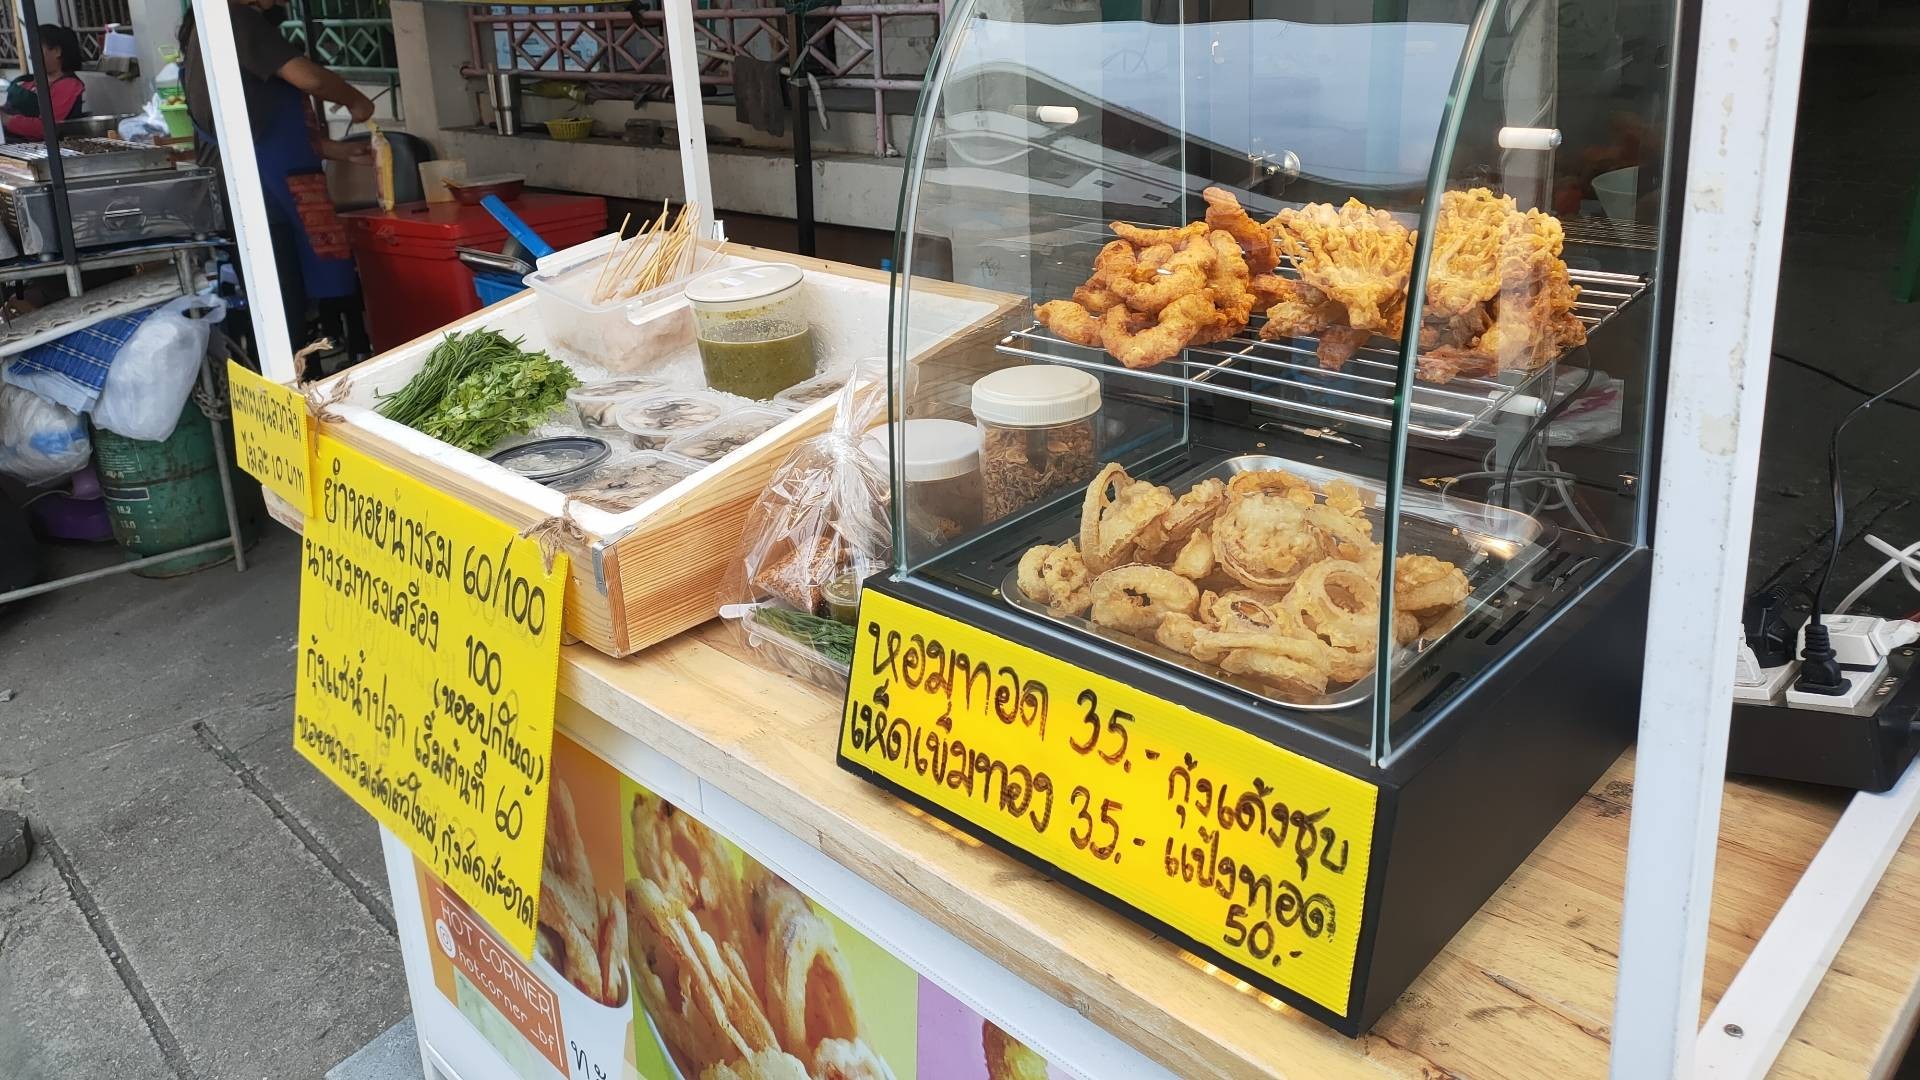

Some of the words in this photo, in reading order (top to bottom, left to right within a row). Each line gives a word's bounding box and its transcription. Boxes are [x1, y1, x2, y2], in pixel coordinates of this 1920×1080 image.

[271, 455, 283, 481] 10
[285, 458, 305, 496] บาท
[463, 535, 546, 636] 60/100
[466, 634, 501, 696] 100
[868, 621, 1049, 742] หอมทอด
[495, 785, 523, 840] 60
[1164, 826, 1337, 943] แป้งทอด
[440, 900, 473, 945] HOT
[480, 938, 553, 1024] CORNER
